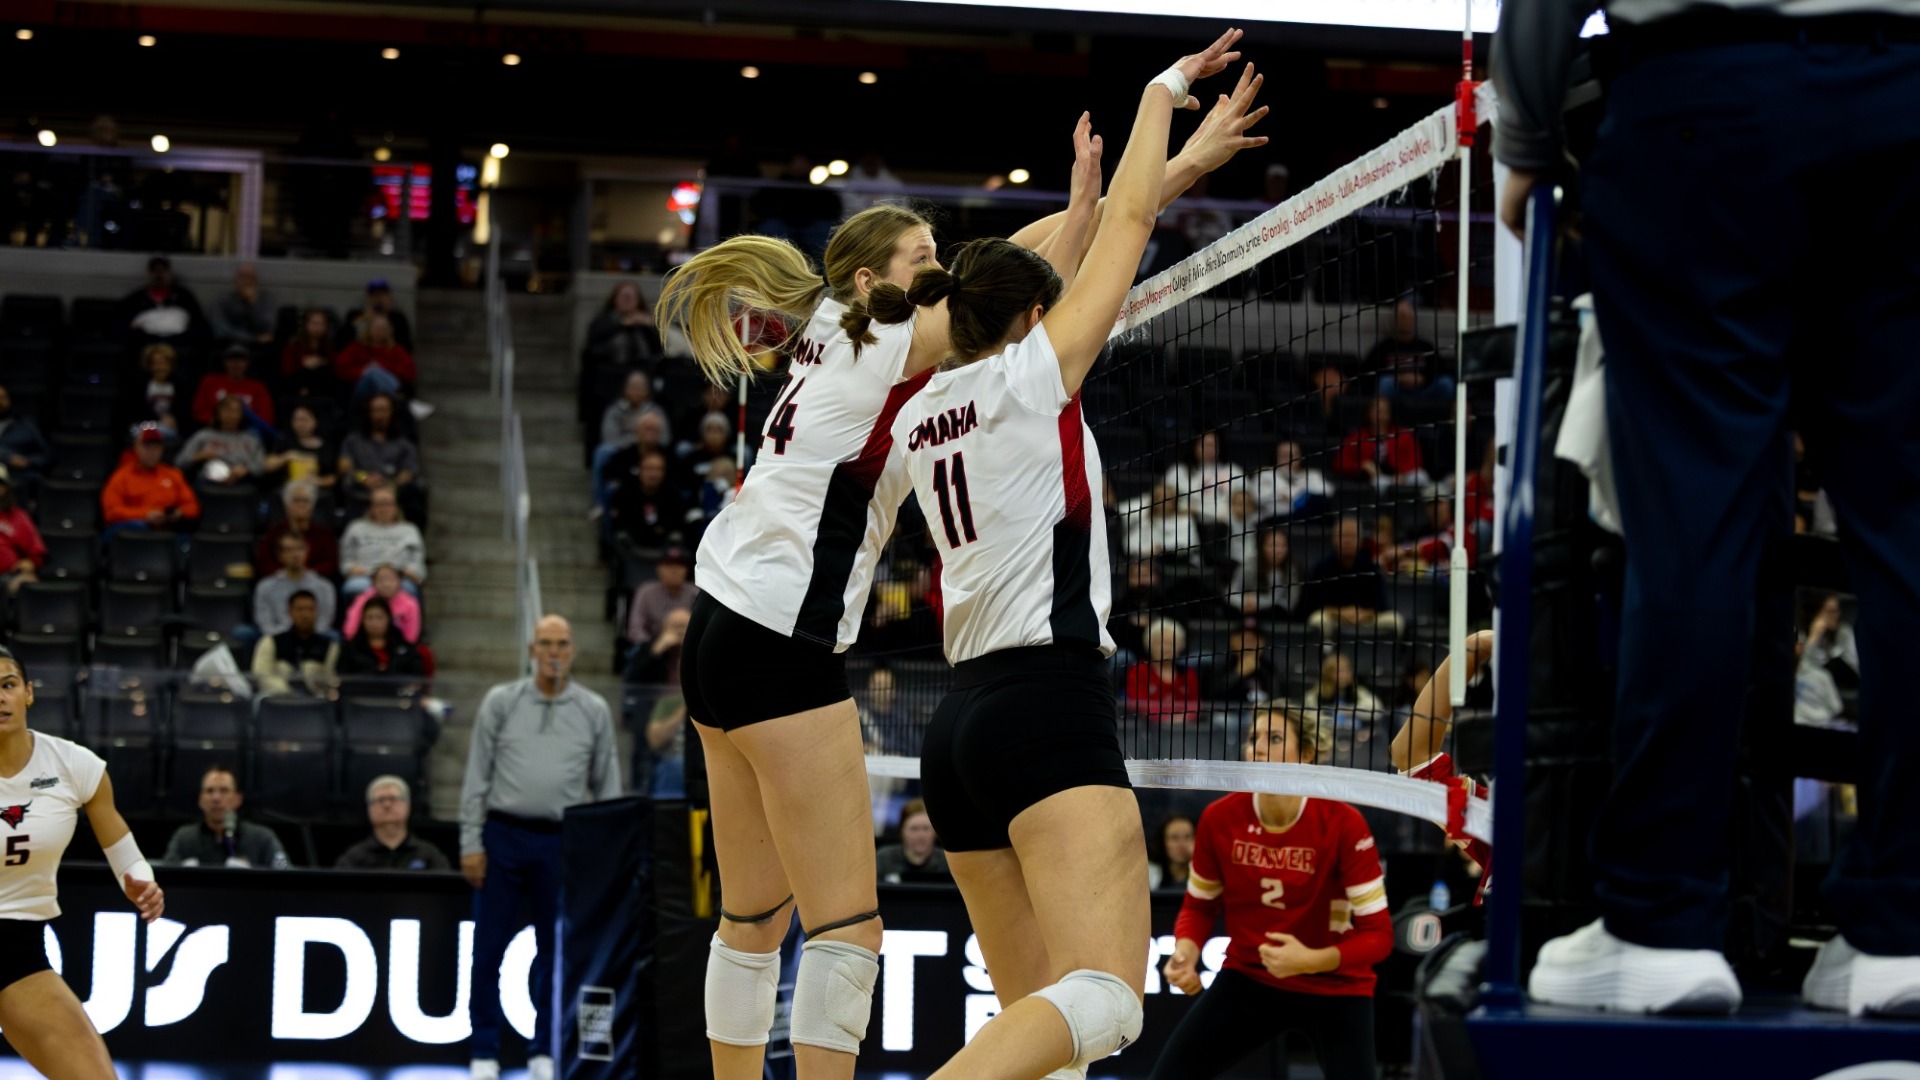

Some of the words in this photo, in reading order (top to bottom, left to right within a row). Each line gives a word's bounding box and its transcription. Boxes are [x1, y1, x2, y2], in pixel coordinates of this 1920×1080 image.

[908, 400, 979, 452] OMAHA
[933, 450, 978, 549] 11
[5, 834, 31, 867] 5
[1231, 839, 1316, 875] DENVER
[1259, 877, 1287, 910] 2
